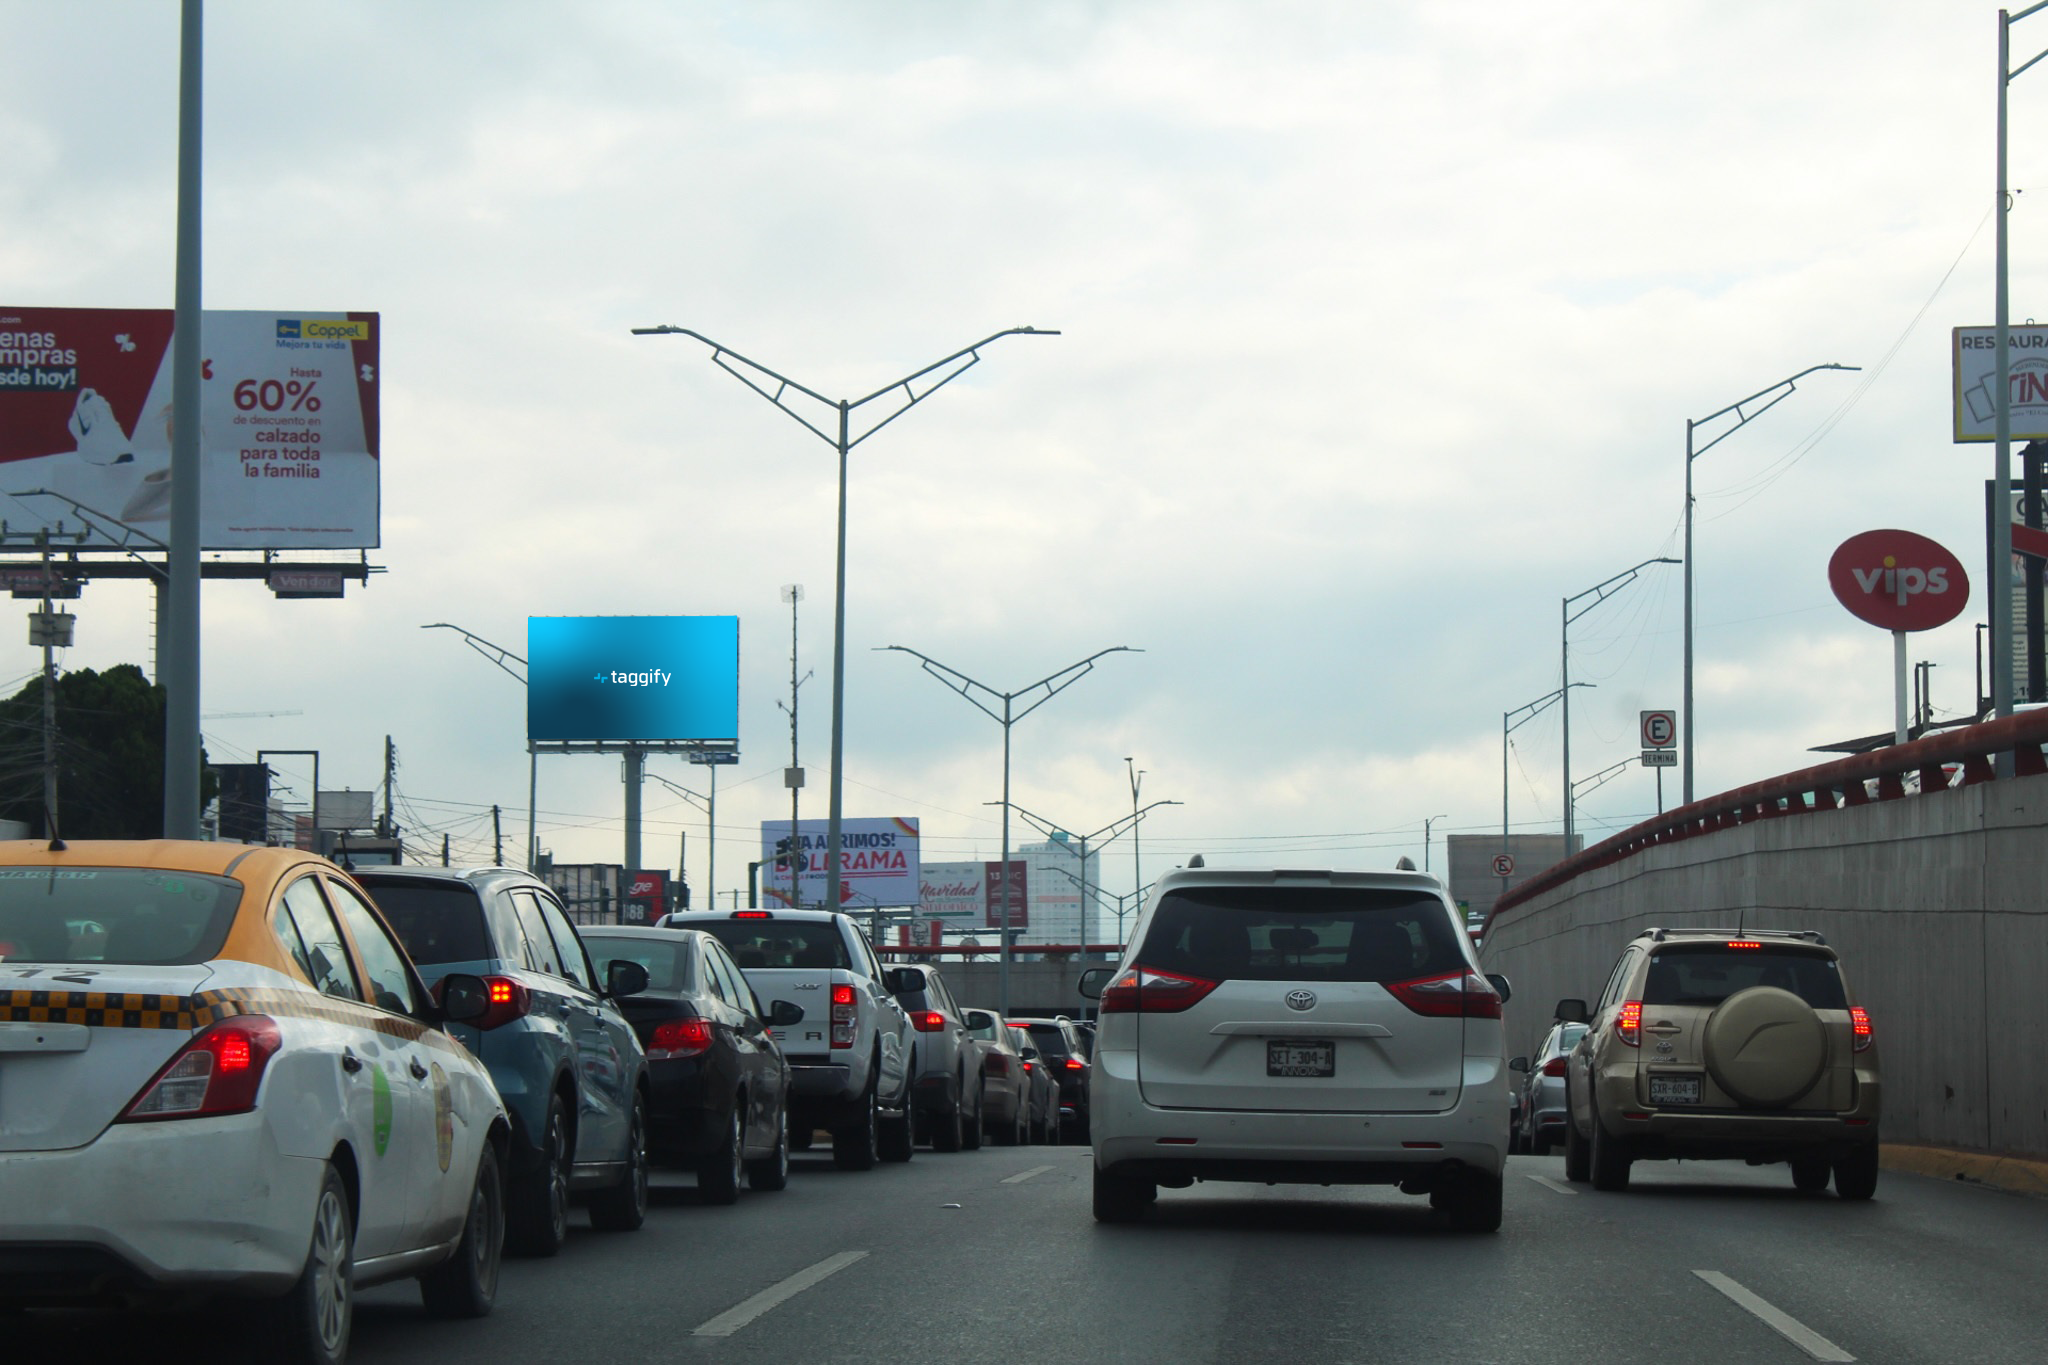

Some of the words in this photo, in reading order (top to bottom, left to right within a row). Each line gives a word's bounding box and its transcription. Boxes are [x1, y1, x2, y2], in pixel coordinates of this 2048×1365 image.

[307, 324, 360, 339] Coppel
[276, 340, 310, 350] Mejora
[325, 341, 346, 349] vida
[1961, 336, 2048, 349] RESAUR
[35, 368, 76, 389] hoy!
[290, 368, 320, 378] Hasta
[233, 379, 321, 413] 60%
[233, 416, 247, 424] de
[249, 415, 305, 425] descuento
[255, 428, 320, 443] calzado
[240, 449, 278, 463] para
[282, 446, 320, 460] toda
[245, 463, 259, 477] la
[263, 463, 320, 478] familia
[1852, 556, 1949, 606] vips
[611, 668, 671, 686] taggify
[1652, 720, 1666, 739] E
[1645, 754, 1675, 763] TERMINA
[815, 832, 896, 850] ARIMOS!
[990, 872, 1000, 880] 13
[919, 880, 979, 902] Navidad
[1270, 1050, 1331, 1065] SET-304-A
